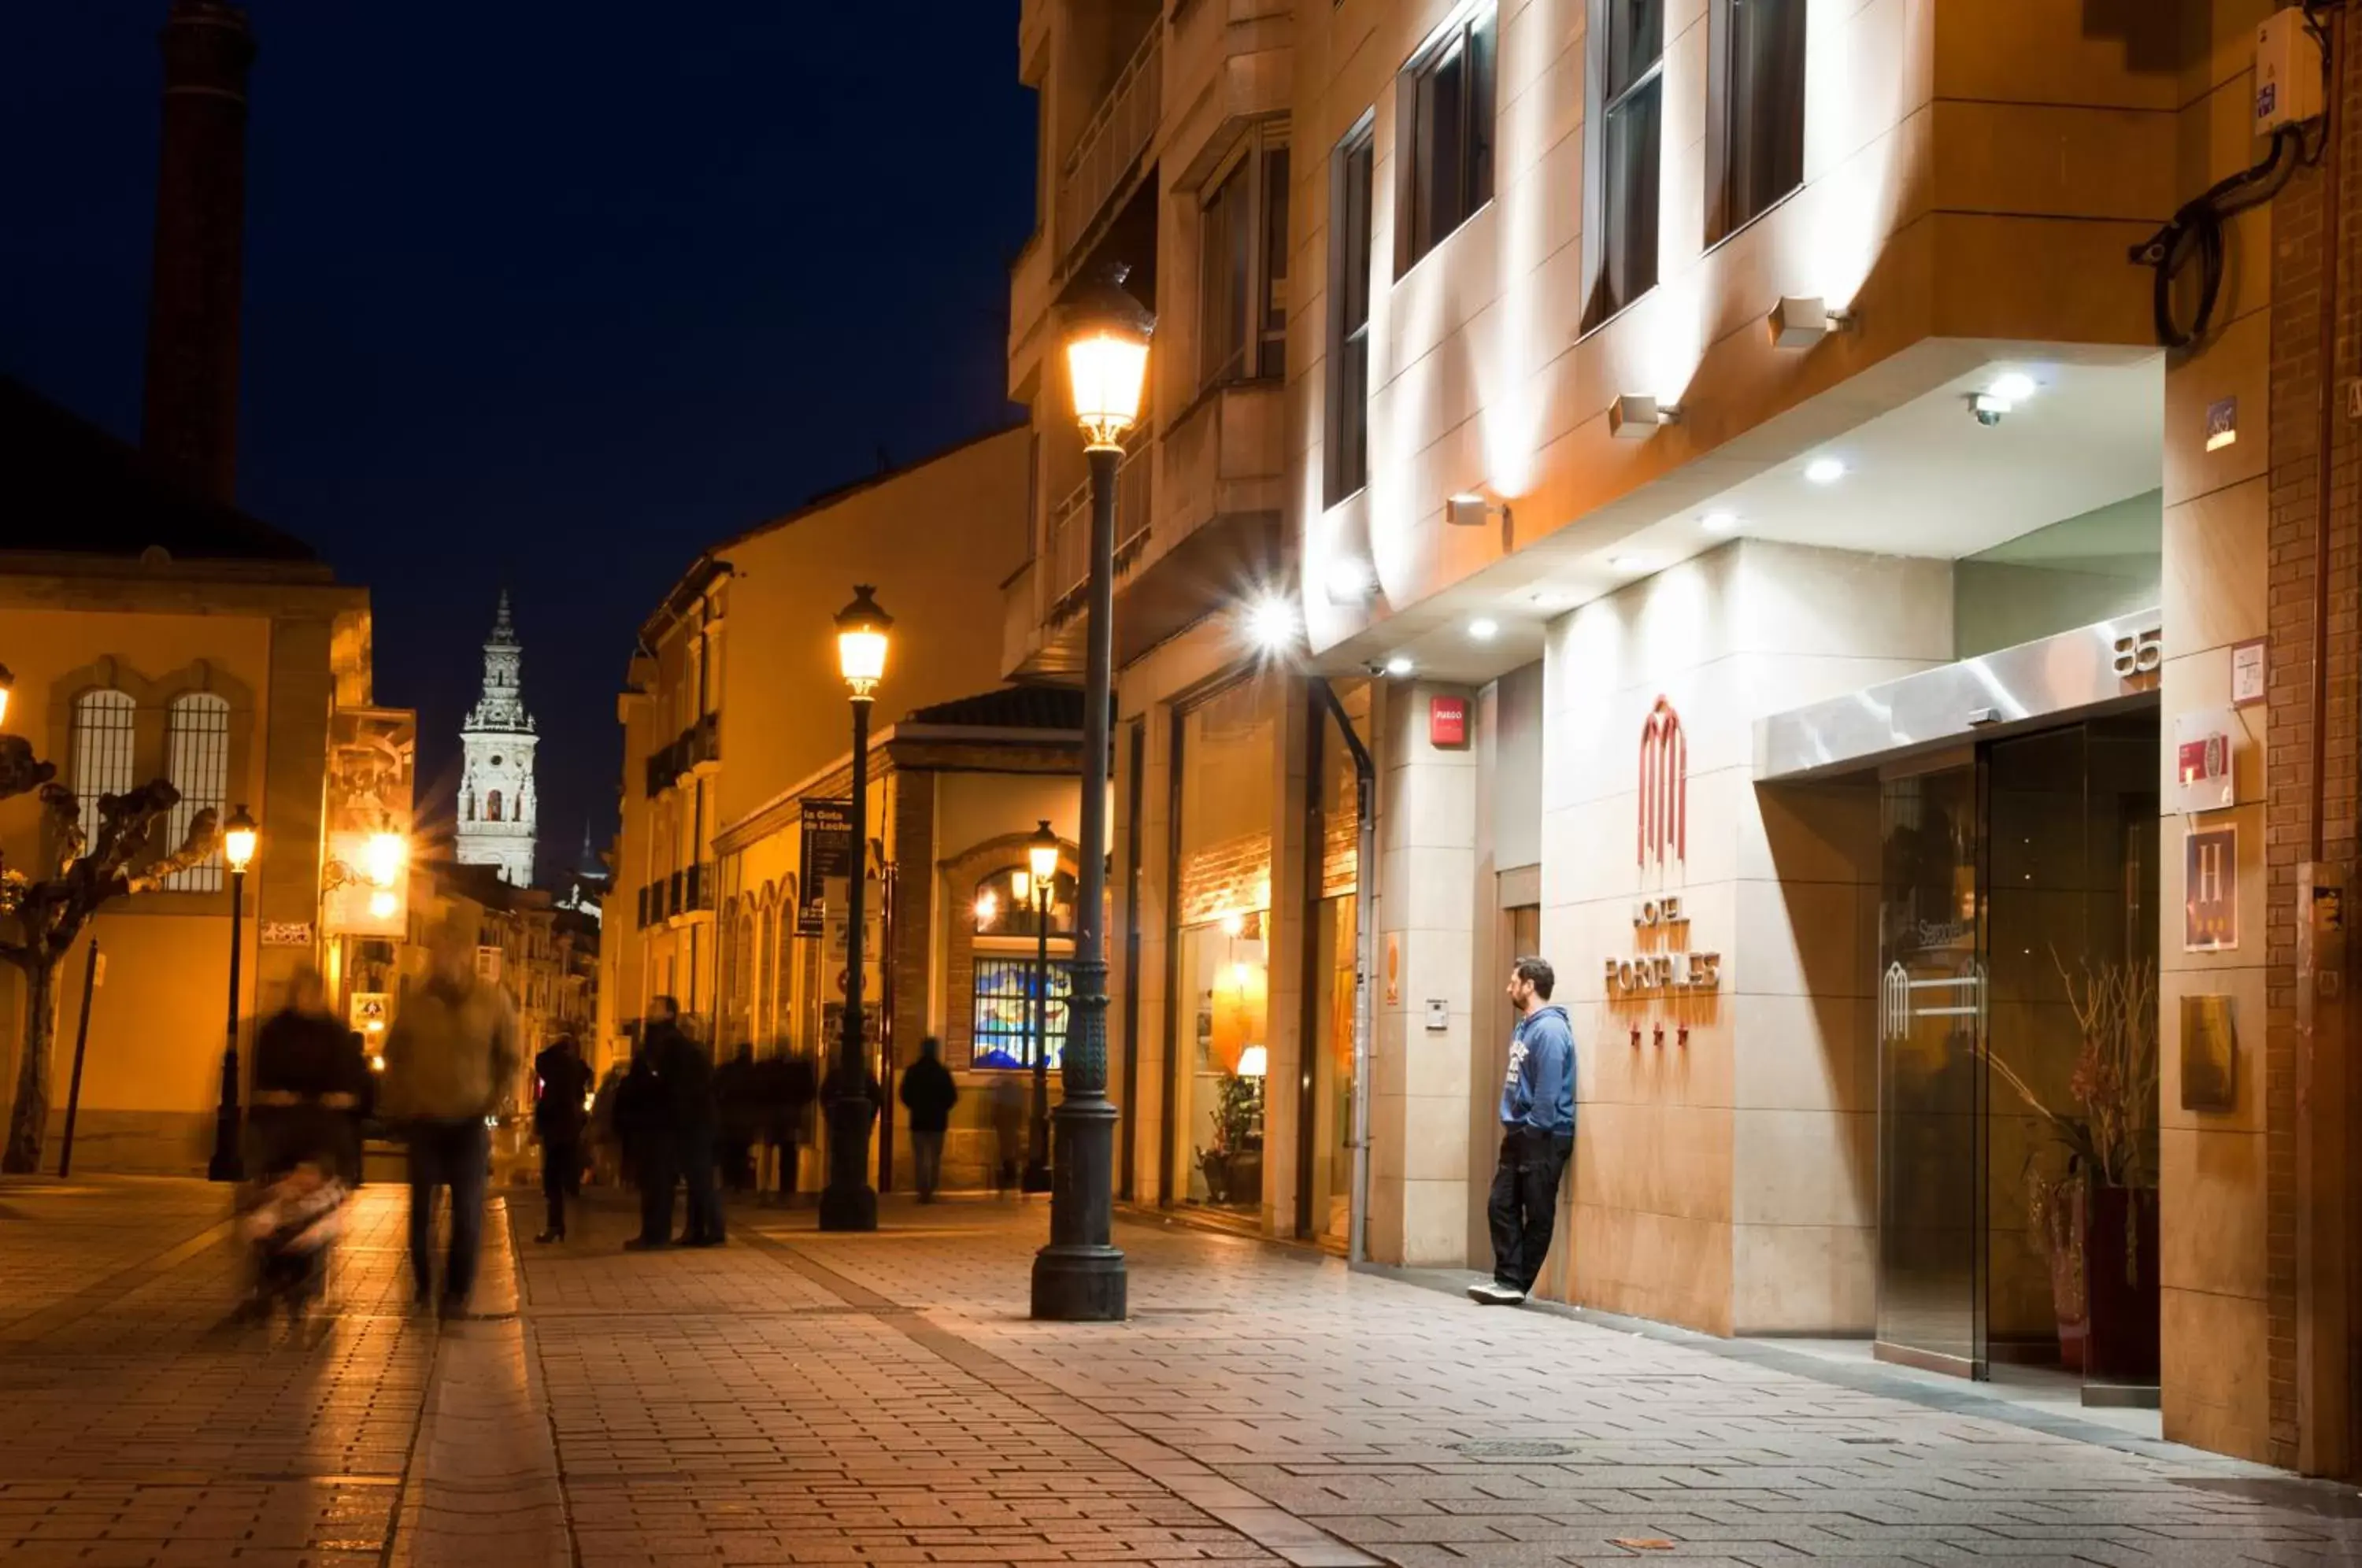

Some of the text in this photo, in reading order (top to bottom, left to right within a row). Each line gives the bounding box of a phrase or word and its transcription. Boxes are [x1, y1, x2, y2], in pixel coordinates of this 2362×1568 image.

[2112, 623, 2162, 677] 85
[2199, 843, 2223, 904] H
[1605, 952, 1721, 992] PORTALES
